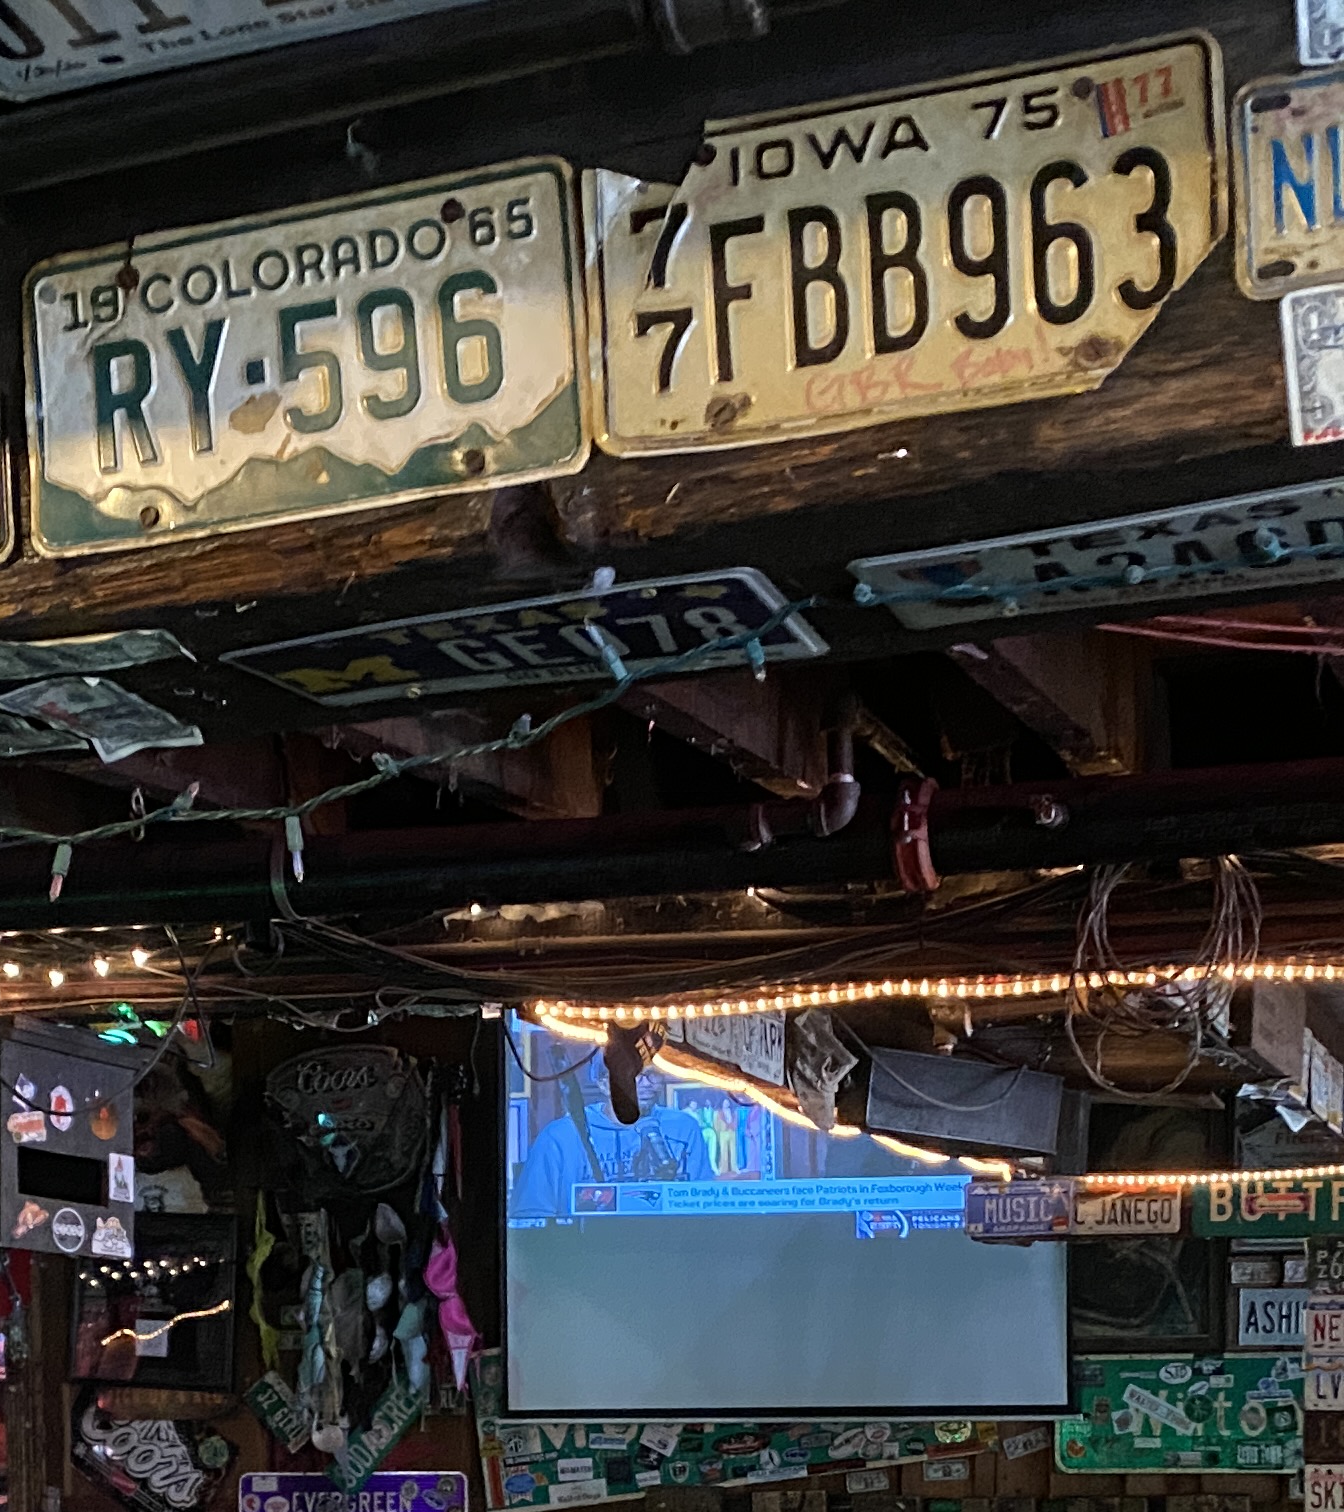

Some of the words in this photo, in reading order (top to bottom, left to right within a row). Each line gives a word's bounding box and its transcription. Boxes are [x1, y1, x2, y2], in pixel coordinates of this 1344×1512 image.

[730, 115, 930, 187] IOWA
[972, 86, 1061, 141] 75
[141, 218, 447, 316] COLORADO
[468, 198, 536, 246] 65
[708, 145, 1177, 384] FBB963
[1026, 495, 1303, 559] TEXAS
[368, 600, 610, 648] TEXAS
[297, 1060, 376, 1095] Coors
[667, 1187, 689, 1198] Tom
[690, 1187, 720, 1199] Brady
[732, 1186, 791, 1197] Buccaneers
[792, 1185, 814, 1195] face
[816, 1184, 858, 1195] Patriots
[870, 1182, 934, 1196] Foxborough
[758, 1199, 798, 1209] soaring
[818, 1196, 862, 1208] Brady's
[864, 1195, 900, 1206] return
[984, 1196, 1053, 1225] MUSIC
